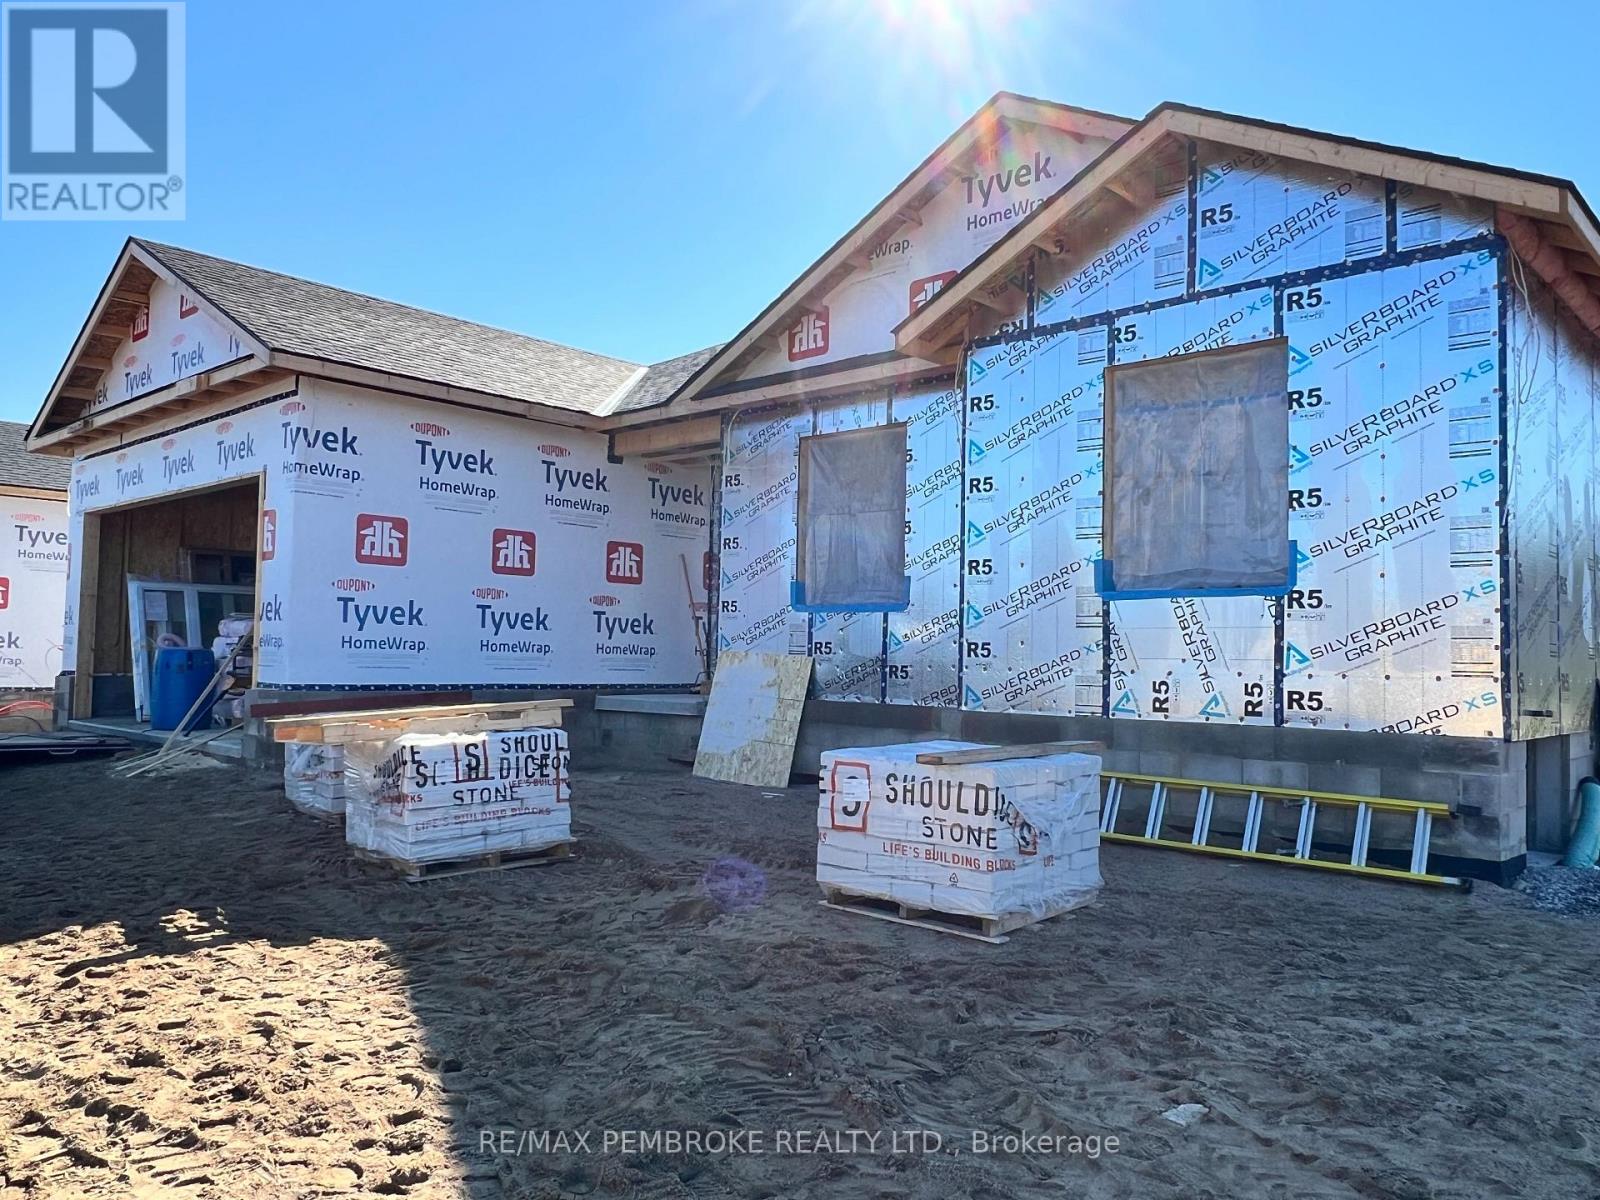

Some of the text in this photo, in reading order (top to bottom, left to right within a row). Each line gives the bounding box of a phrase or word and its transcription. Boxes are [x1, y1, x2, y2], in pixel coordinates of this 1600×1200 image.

[962, 151, 1051, 207] Tyvek
[1201, 203, 1233, 228] R5
[1220, 182, 1353, 270] SILVERBOARD
[1251, 204, 1341, 265] GRAPHITE
[1053, 221, 1160, 297] SILVERBOARD
[1078, 240, 1151, 294] GRAPHITE
[1287, 288, 1323, 312] R5
[1310, 271, 1456, 357] SILVERBOARD
[1459, 250, 1493, 275] XS
[1344, 293, 1444, 353] GRAPHITE
[171, 341, 205, 379] Tyvek
[124, 363, 153, 398] Tyvek
[970, 395, 994, 412] R5
[1288, 387, 1323, 411] R5
[1310, 378, 1457, 457] SILVERBOARD
[1460, 360, 1494, 383] XS
[984, 386, 1083, 451] SILVERBOARD
[1008, 404, 1074, 449] GRAPHITE
[1344, 400, 1444, 455] GRAPHITE
[217, 432, 255, 471] Tyvek
[282, 422, 358, 456] Tyvek
[163, 448, 194, 483] Tyvek
[283, 461, 361, 483] HomeWrap
[415, 440, 495, 475] Tyvek
[76, 475, 100, 504] Tyvek
[116, 464, 144, 495] Tyvek
[419, 477, 496, 500] HomeWrap
[541, 460, 608, 492] Tyvek
[648, 477, 704, 506] Tyvek
[725, 474, 741, 488] R5
[969, 476, 993, 494] R5
[545, 494, 610, 515] HomeWrap
[733, 472, 796, 518] SILVERBOARD
[748, 485, 791, 518] GRAPHITE
[984, 473, 1082, 533] SILVERBOARD
[1288, 488, 1323, 510] R5
[651, 508, 706, 528] HomeWrap
[1007, 491, 1073, 533] GRAPHITE
[1310, 485, 1457, 558] SILVERBOARD
[1461, 469, 1495, 492] XS
[14, 525, 68, 547] Tyve
[723, 537, 739, 550] R5
[1344, 507, 1445, 558] GRAPHITE
[731, 538, 796, 581] SILVERBOARD
[747, 551, 789, 582] GRAPHITE
[967, 559, 993, 575] R5
[337, 579, 370, 592] DUPONT
[983, 561, 1082, 616] SILVERBOARD
[1006, 578, 1072, 617] GRAPHITE
[1287, 589, 1323, 609] R5
[337, 597, 424, 631] Tyvek
[476, 604, 548, 636] Tyvek
[721, 600, 738, 613] R5
[1310, 594, 1458, 659] SILVERBOARD
[1462, 580, 1497, 601] XS
[0, 632, 19, 649] ek
[593, 610, 654, 639] Tyvek
[745, 618, 788, 645] GRAPHITE
[1345, 615, 1446, 662] GRAPHITE
[341, 636, 426, 653] HomeWrap
[480, 639, 551, 656] HomeWrap
[596, 643, 656, 658] HomeWrap
[814, 642, 832, 655] R5
[966, 642, 991, 658] R5
[889, 665, 909, 679] R5
[981, 649, 1081, 699] SILVERBOARD
[1005, 666, 1073, 702] GRAPHITE
[1152, 680, 1169, 713] R5
[1244, 682, 1263, 717] R5
[1287, 690, 1323, 711] R5
[1464, 692, 1498, 712] XS
[453, 785, 518, 806] STONE
[922, 816, 998, 850] STONE
[883, 842, 920, 857] LIFE'S
[925, 849, 981, 870] BUILDING
